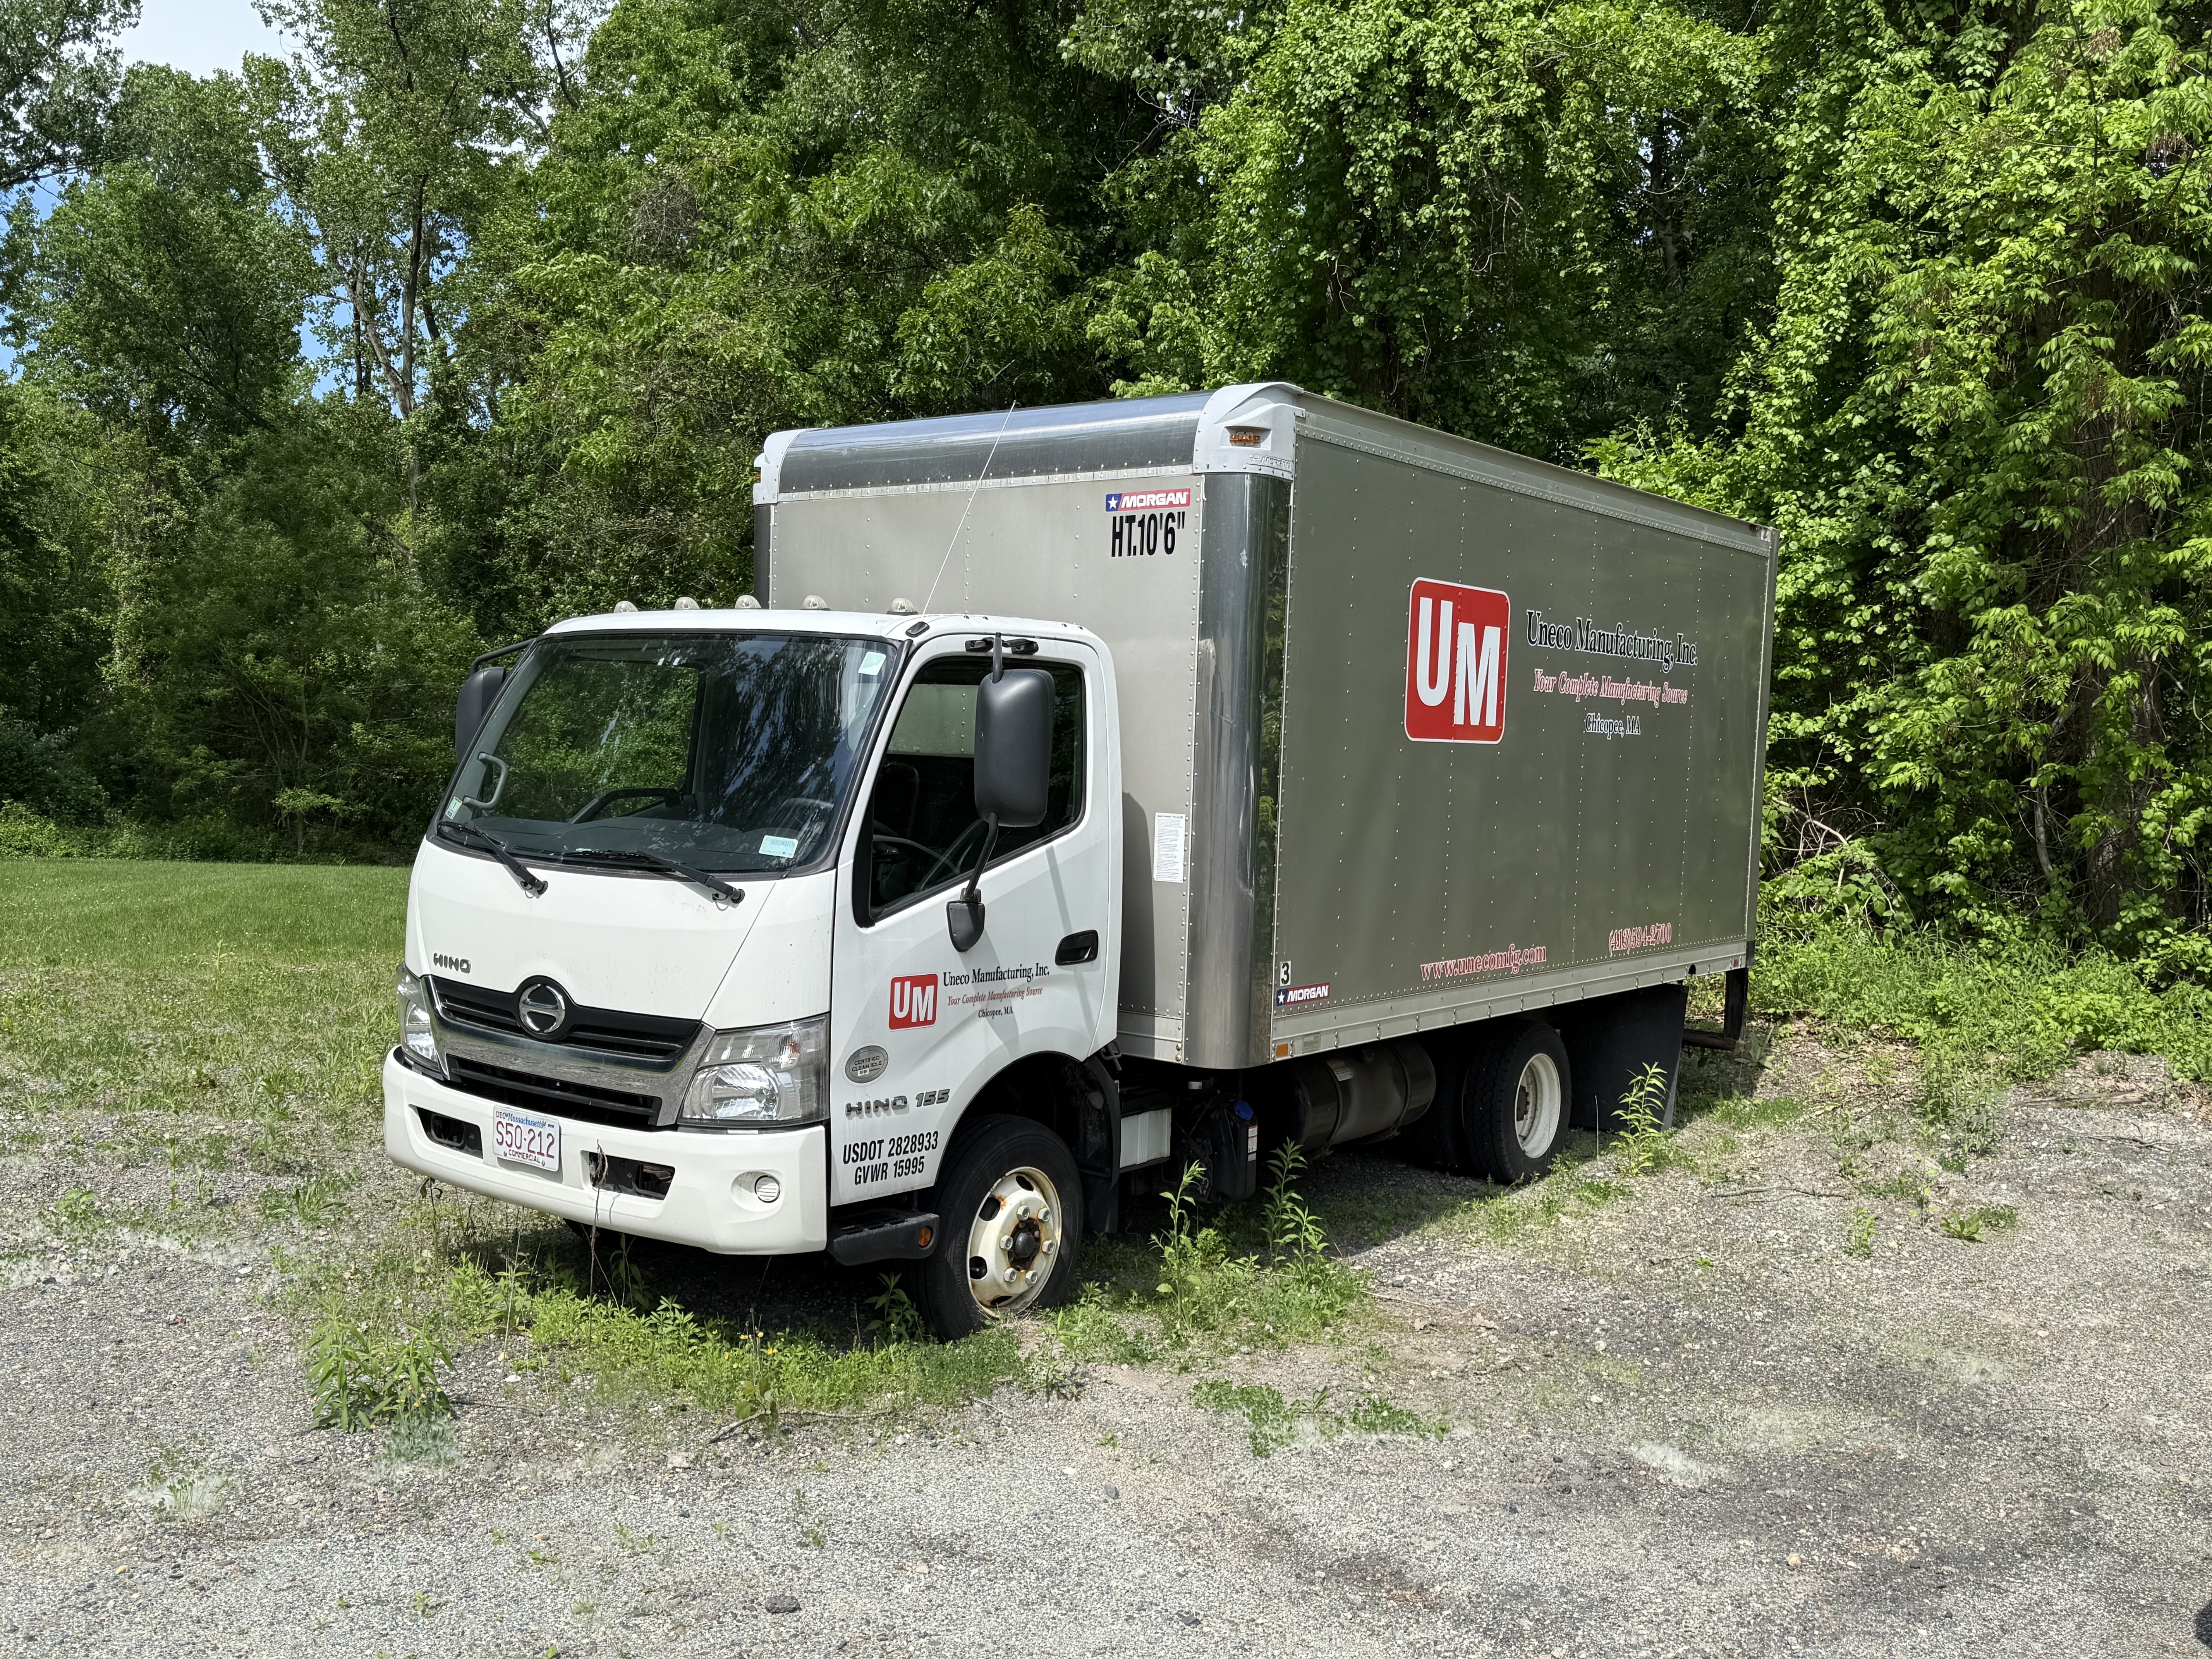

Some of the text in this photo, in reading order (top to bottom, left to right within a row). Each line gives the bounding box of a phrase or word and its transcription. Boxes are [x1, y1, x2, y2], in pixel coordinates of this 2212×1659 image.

[1121, 492, 1188, 508] MORGAN
[1527, 610, 1698, 673] Uneco Manufacturing, Inc.
[1416, 597, 1501, 726] UM
[1534, 669, 1688, 708] Your Complete Manufacturing Source
[1585, 713, 1641, 740] Chicopee, MA
[1608, 922, 1672, 957] (413)594-2700
[433, 952, 471, 974] HINO
[943, 963, 1049, 986] Uneco Manufacturing, Inc.
[1281, 962, 1290, 984] 3
[1420, 943, 1547, 981] www.unecomfg.com
[893, 981, 934, 1022] UM
[948, 987, 1042, 1006] Your Complete Manufacturing Source
[1287, 985, 1329, 1003] MORGAN
[978, 1006, 1013, 1019] Chicopee, MA
[496, 1111, 506, 1119] DEC
[845, 1089, 950, 1116] HINO 155
[508, 1112, 544, 1129] Massachusetts
[508, 1149, 541, 1163] COMMERCIAL
[843, 1130, 938, 1164] USDOT 2828933
[854, 1156, 925, 1185] GVWR 15995
